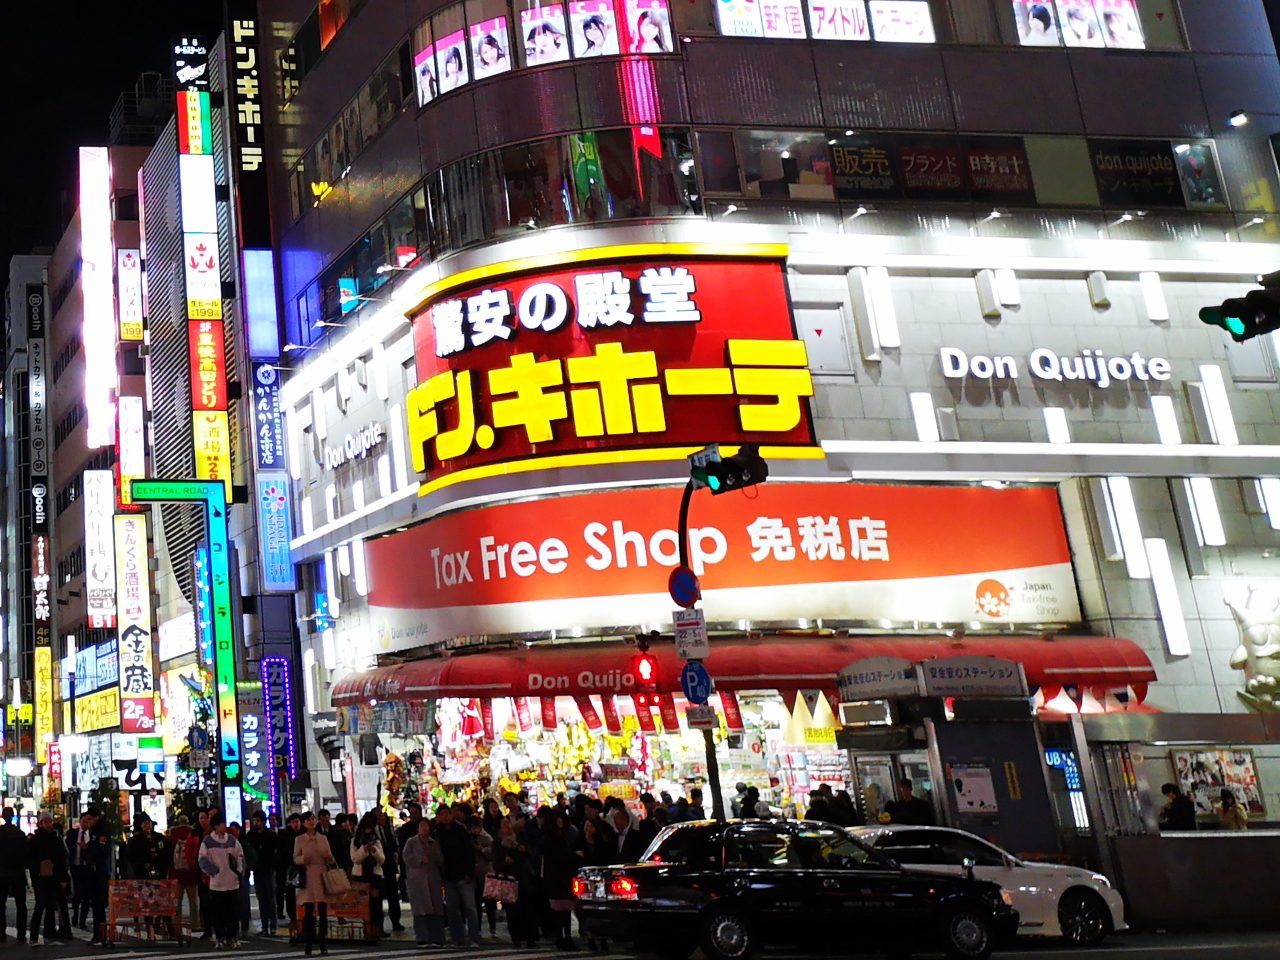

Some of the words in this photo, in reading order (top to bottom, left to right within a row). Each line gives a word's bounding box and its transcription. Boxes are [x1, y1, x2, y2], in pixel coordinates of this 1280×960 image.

[812, 6, 865, 36] アイドル
[833, 147, 892, 175] 販売
[902, 154, 958, 173] ブランド
[29, 293, 43, 331] Booth
[195, 308, 214, 317] 199
[432, 266, 702, 357] 驚安の殿堂
[939, 346, 1019, 380] Don
[1029, 347, 1172, 388] Quijote
[325, 441, 346, 471] Don
[345, 420, 383, 460] Quijote
[31, 483, 47, 524] Booth
[136, 486, 180, 496] CENTRAL
[183, 486, 210, 496] ROAD
[430, 545, 474, 591] Tax
[481, 533, 569, 582] Free
[584, 519, 729, 576] Shop
[746, 515, 891, 563] 免税店
[528, 674, 570, 690] Don
[577, 670, 636, 690] Quijo
[686, 671, 699, 698] P
[123, 699, 144, 720] 2F
[269, 665, 289, 750] カラオケ
[242, 714, 263, 786] カラオケ
